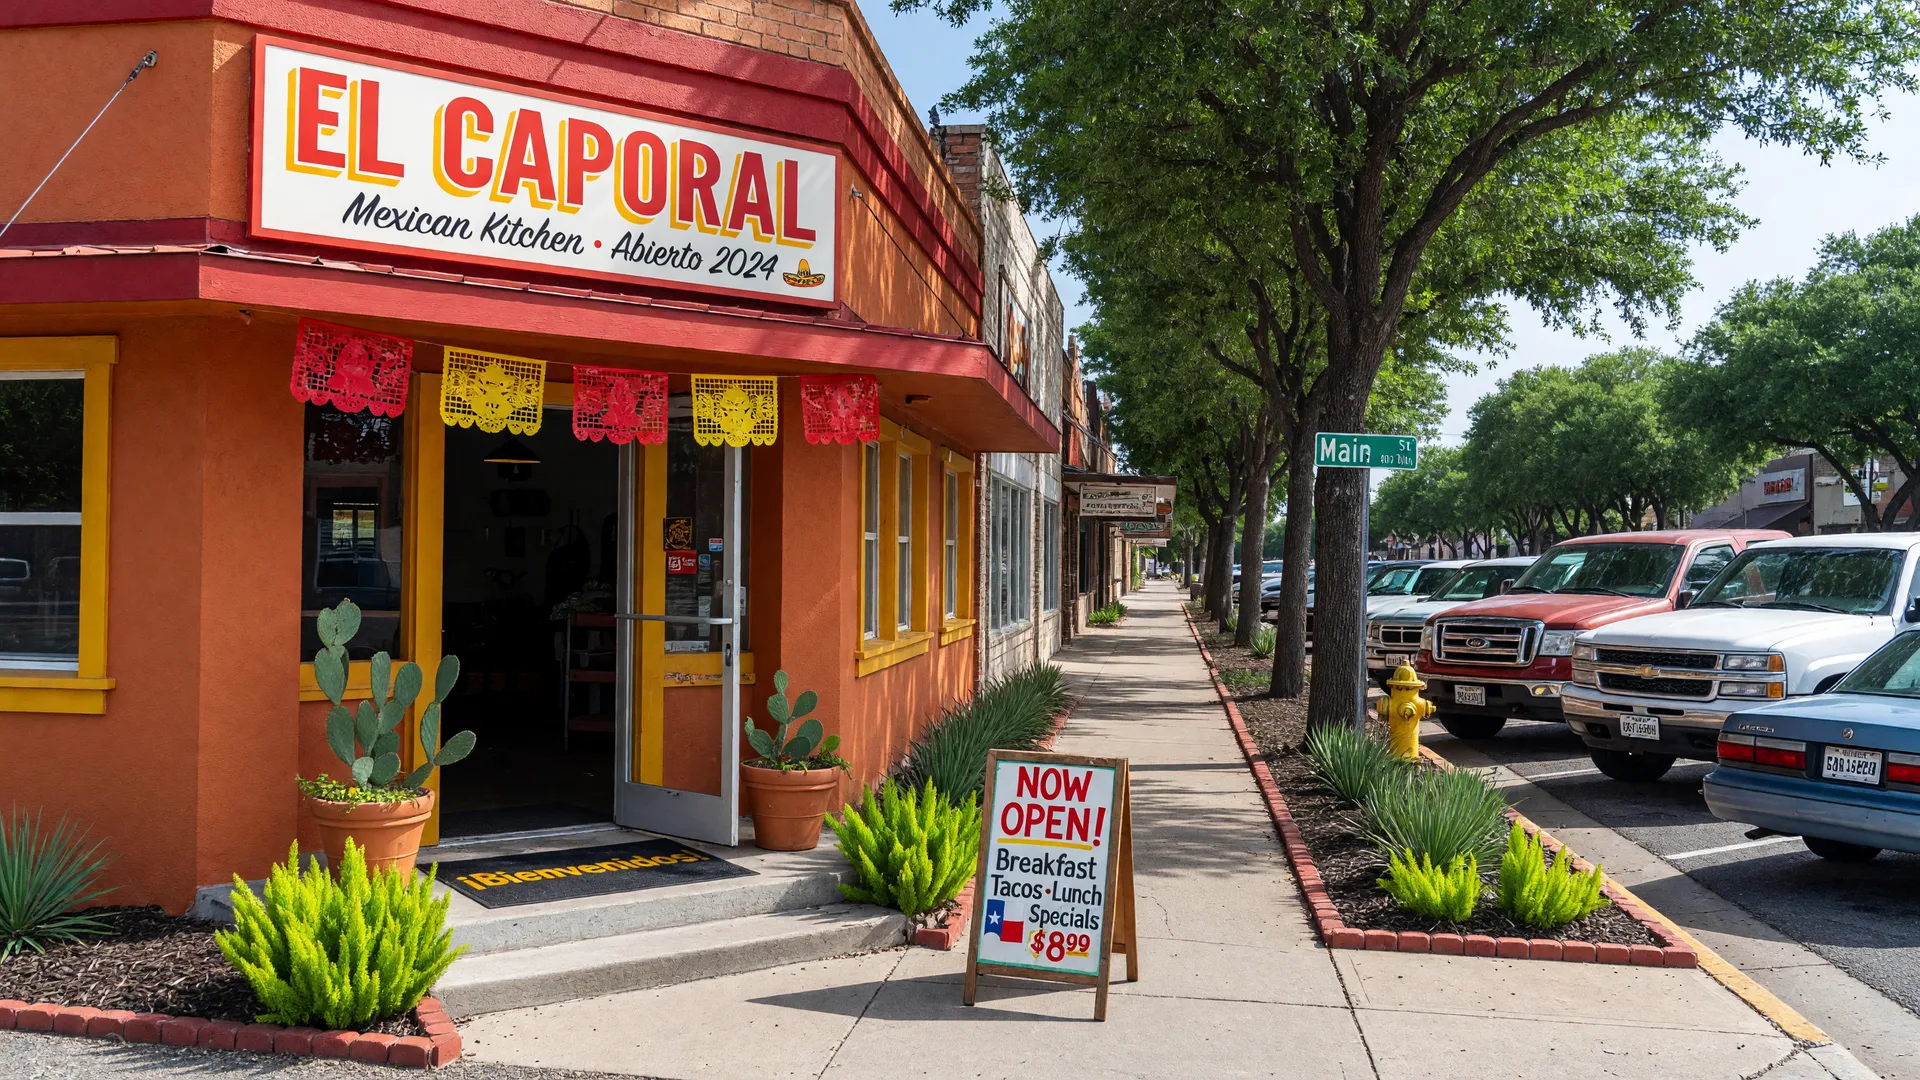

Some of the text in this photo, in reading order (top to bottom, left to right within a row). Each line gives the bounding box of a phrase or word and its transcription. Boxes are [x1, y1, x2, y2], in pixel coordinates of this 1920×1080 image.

[286, 67, 817, 249] EL CAPORAL
[342, 192, 780, 281] Mexican Kitchen Abierto 2024
[1320, 437, 1371, 463] Main
[1016, 766, 1093, 802] NOW
[1000, 802, 1106, 847] OPEN!
[456, 849, 710, 891] ¡Bienvenidos!
[996, 848, 1097, 880] Breakfast
[1028, 904, 1100, 930] Specials
